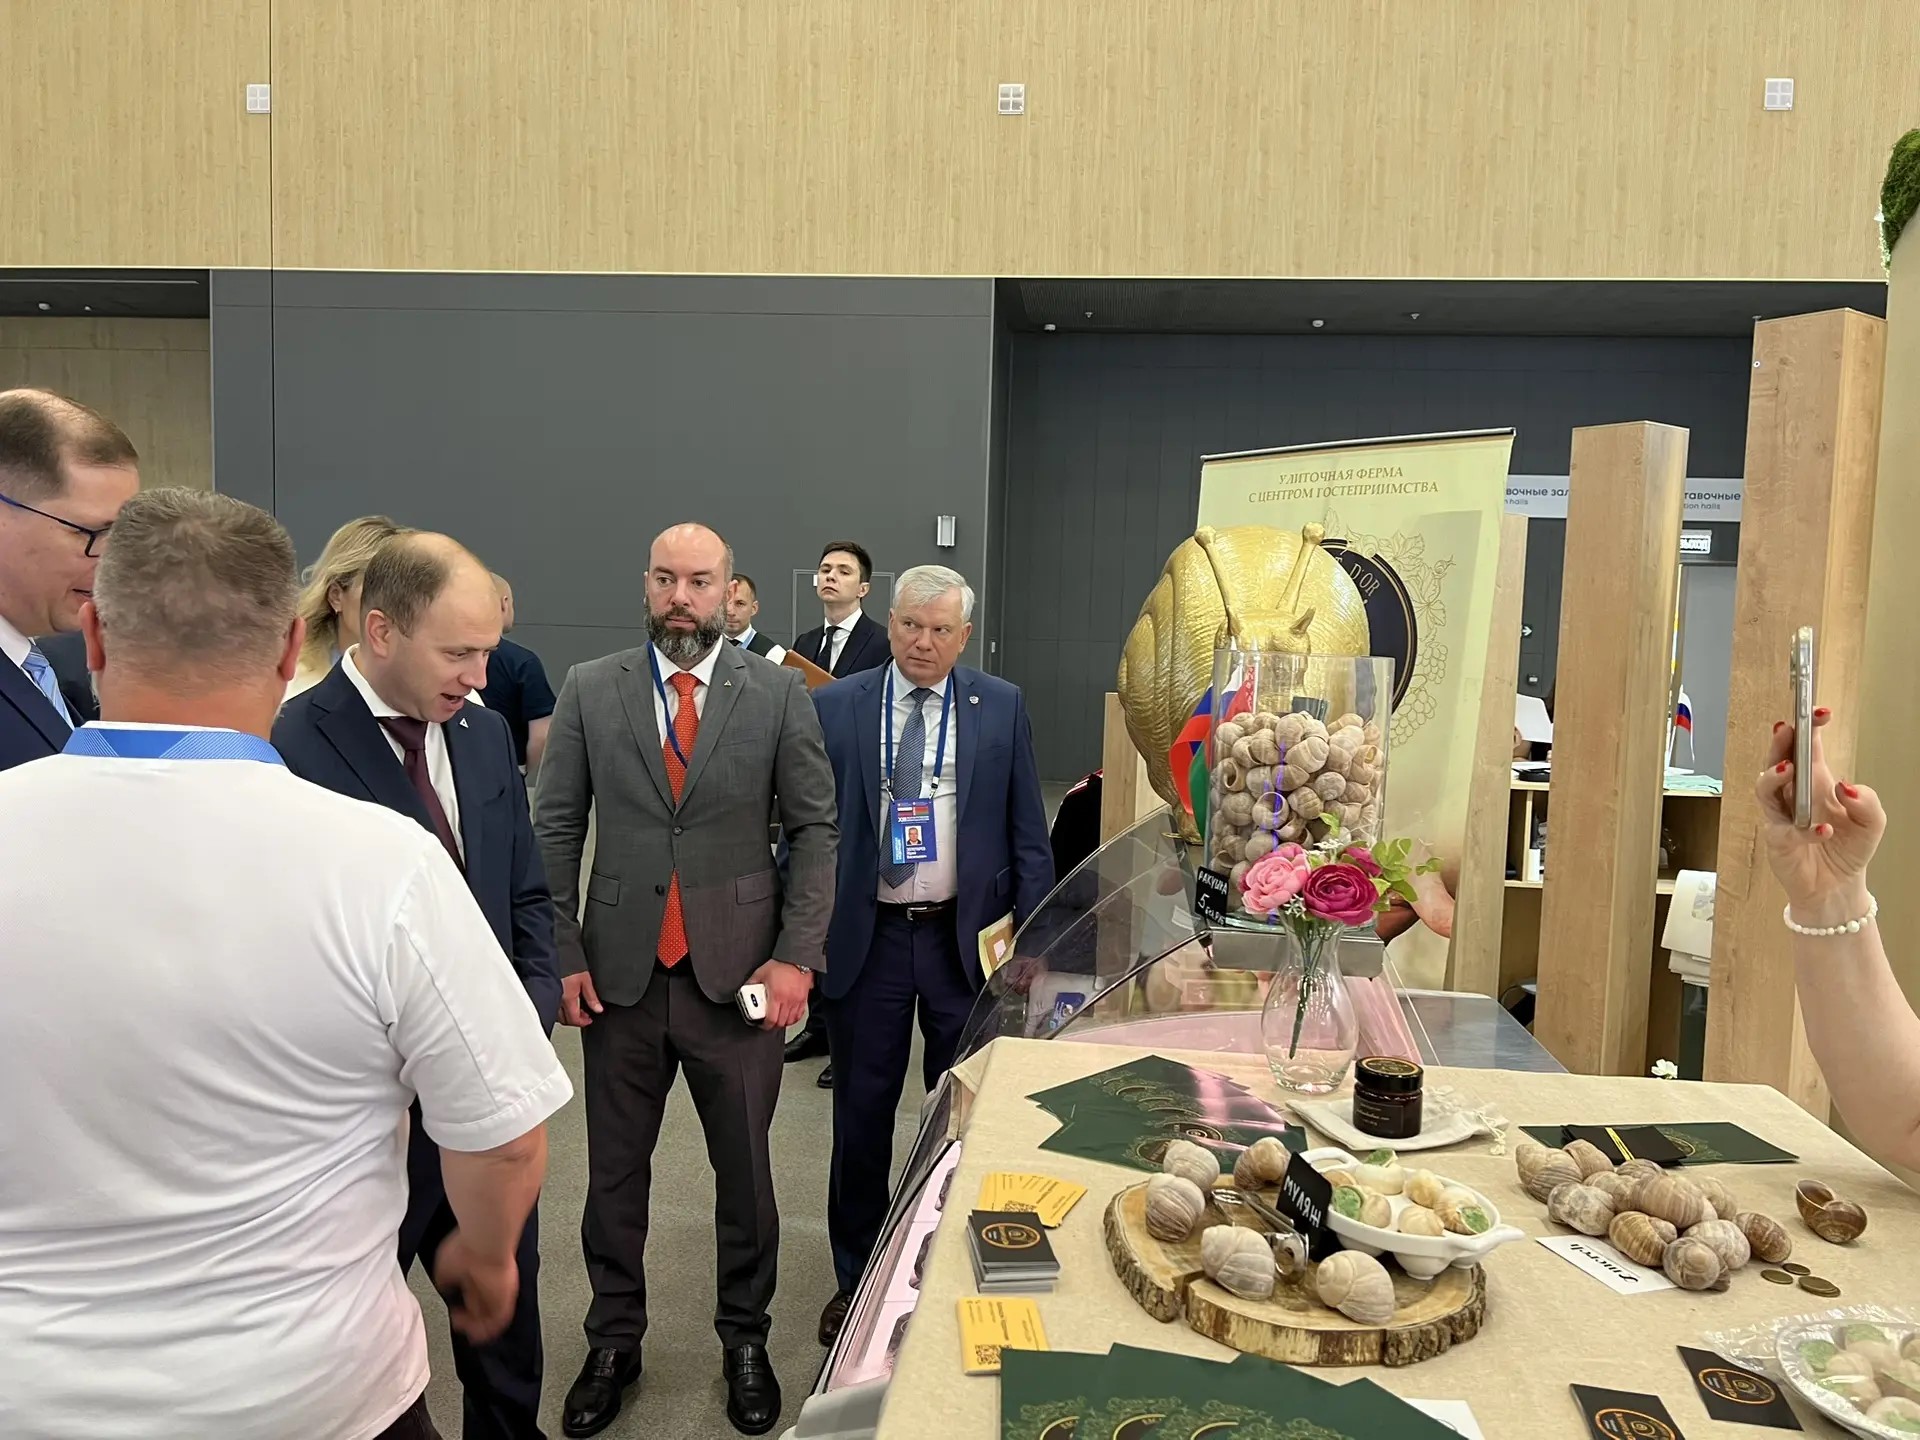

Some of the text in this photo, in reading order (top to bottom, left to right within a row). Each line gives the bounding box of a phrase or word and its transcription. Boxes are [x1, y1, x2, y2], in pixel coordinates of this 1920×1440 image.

[1279, 466, 1403, 485] УЛИТОЧНАЯ ФЕРМА
[1248, 481, 1438, 503] С ЦЕНТРОМ ГОСТЕПРИИМСТВА
[1197, 892, 1210, 909] 5
[1283, 1175, 1322, 1228] МУЛЯЖ
